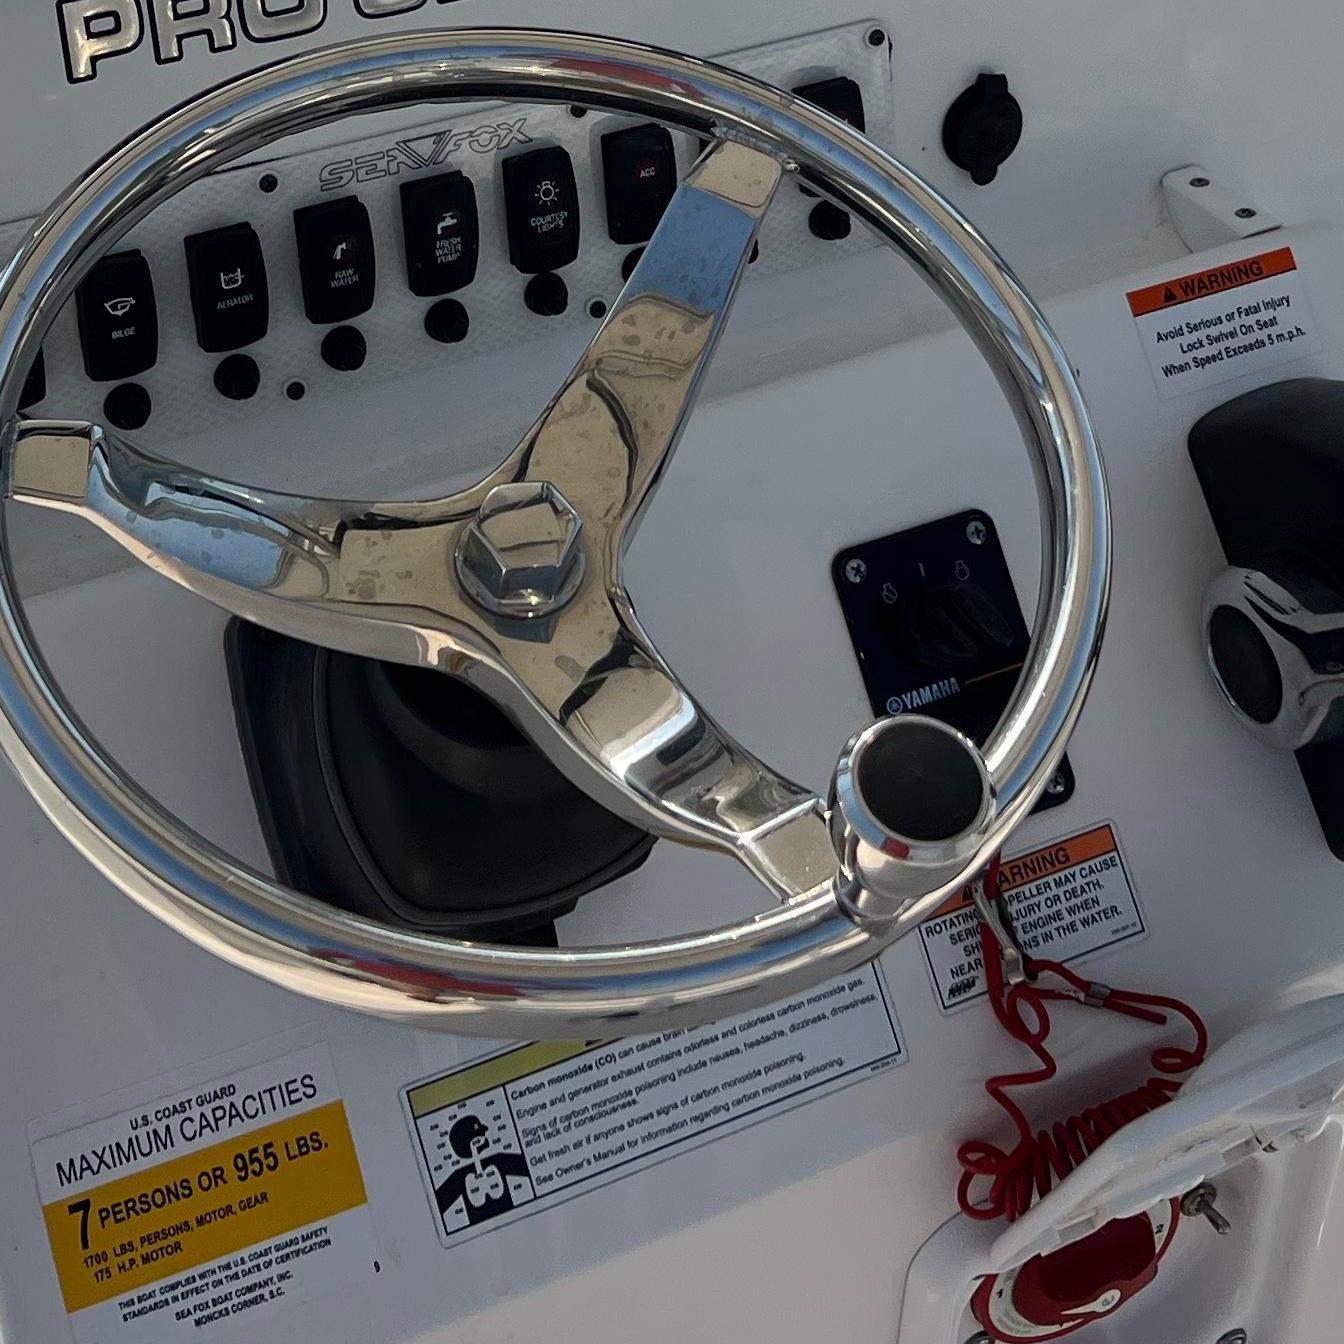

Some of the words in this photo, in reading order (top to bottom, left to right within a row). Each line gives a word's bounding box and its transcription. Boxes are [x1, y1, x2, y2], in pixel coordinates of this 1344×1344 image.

[640, 167, 655, 178] ACC
[335, 268, 355, 280] RAW
[1179, 261, 1263, 297] WARNING
[1157, 325, 1184, 343] Avoid
[1185, 316, 1223, 334] Serious
[1225, 312, 1235, 322] or
[1236, 302, 1262, 319] Fatal
[1262, 296, 1290, 311] Injury
[1180, 338, 1205, 354] Lock
[1206, 327, 1238, 346] Swivel
[1239, 324, 1255, 336] On
[1255, 316, 1278, 331] Seat
[1161, 362, 1191, 378] When
[1192, 349, 1224, 369] Speed
[1224, 338, 1266, 358] Exceeds
[1267, 334, 1274, 345] 5
[1276, 326, 1307, 343] m.p.h.
[902, 677, 960, 710] YAMAHA
[995, 847, 1070, 889] ARNING
[1053, 870, 1076, 889] MAY
[1079, 856, 1118, 879] CAUSE
[1021, 909, 1064, 935] ENGINE
[1065, 895, 1100, 917] WHEN
[1044, 894, 1062, 909] OR
[1063, 878, 1105, 902] DEATH.
[950, 958, 983, 979] NEAR
[1041, 930, 1054, 944] IN
[1054, 920, 1078, 938] THE
[1079, 905, 1123, 928] WATER.
[511, 1082, 545, 1100] Carbon
[547, 1064, 593, 1087] monoxide
[595, 1053, 616, 1070] (CO)
[618, 1047, 634, 1059] can
[636, 1037, 661, 1052] cause
[516, 1102, 547, 1120] Engine
[549, 1093, 566, 1107] and
[568, 1077, 609, 1102] generator
[611, 1062, 645, 1082] exhaust
[646, 1049, 682, 1068] contains
[684, 1034, 719, 1054] odorless
[721, 1026, 737, 1039] and
[739, 1013, 775, 1032] colorless
[777, 1001, 805, 1017] carbon
[806, 985, 846, 1006] monoxide
[847, 978, 866, 992] gas.
[130, 1115, 153, 1130] U.S.
[154, 1098, 192, 1122] COAST
[196, 1084, 236, 1107] GUARD
[535, 1174, 554, 1186] See
[593, 1143, 625, 1162] Manual
[627, 1138, 638, 1149] for
[640, 1119, 688, 1144] information
[690, 1102, 730, 1124] regarding
[731, 1090, 760, 1107] carbon
[762, 1073, 802, 1095] monoxide
[56, 1124, 175, 1187] MAXIMUM
[180, 1074, 317, 1142] CAPACITIES
[525, 1134, 541, 1148] and
[543, 1128, 561, 1140] lack
[563, 1121, 572, 1133] of
[68, 1199, 91, 1250] 7
[98, 1178, 193, 1229] PERSONS
[198, 1166, 228, 1192] OR
[233, 1142, 279, 1182] 955
[284, 1132, 329, 1161] LBS.
[84, 1251, 108, 1268] 1700
[139, 1220, 194, 1248] PERSONS,
[195, 1204, 237, 1227] MOTOR,
[238, 1192, 269, 1211] GEAR
[94, 1267, 112, 1283] 175
[117, 1258, 140, 1274] H.P.
[140, 1241, 183, 1265] MOTOR
[118, 1298, 135, 1310] THIS
[137, 1289, 156, 1304] BOAT
[159, 1275, 196, 1295] COMPLIES
[197, 1268, 217, 1281] WITH
[217, 1262, 232, 1273] THE
[248, 1246, 272, 1262] COAST
[274, 1237, 299, 1252] GUARD
[301, 1226, 327, 1243] SAFETY
[123, 1298, 170, 1322] STANDARDS
[171, 1295, 179, 1303] IN
[180, 1282, 209, 1300] EFFECT
[211, 1278, 224, 1289] ON
[224, 1271, 241, 1283] THE
[241, 1263, 262, 1278] DATE
[263, 1259, 273, 1269] OF
[275, 1238, 331, 1265] CERTIFICATION
[175, 1308, 193, 1321] SEA
[193, 1301, 210, 1314] FOX
[211, 1291, 233, 1307] BOAT
[277, 1270, 294, 1283] INC.
[194, 1307, 230, 1327] MONCKS
